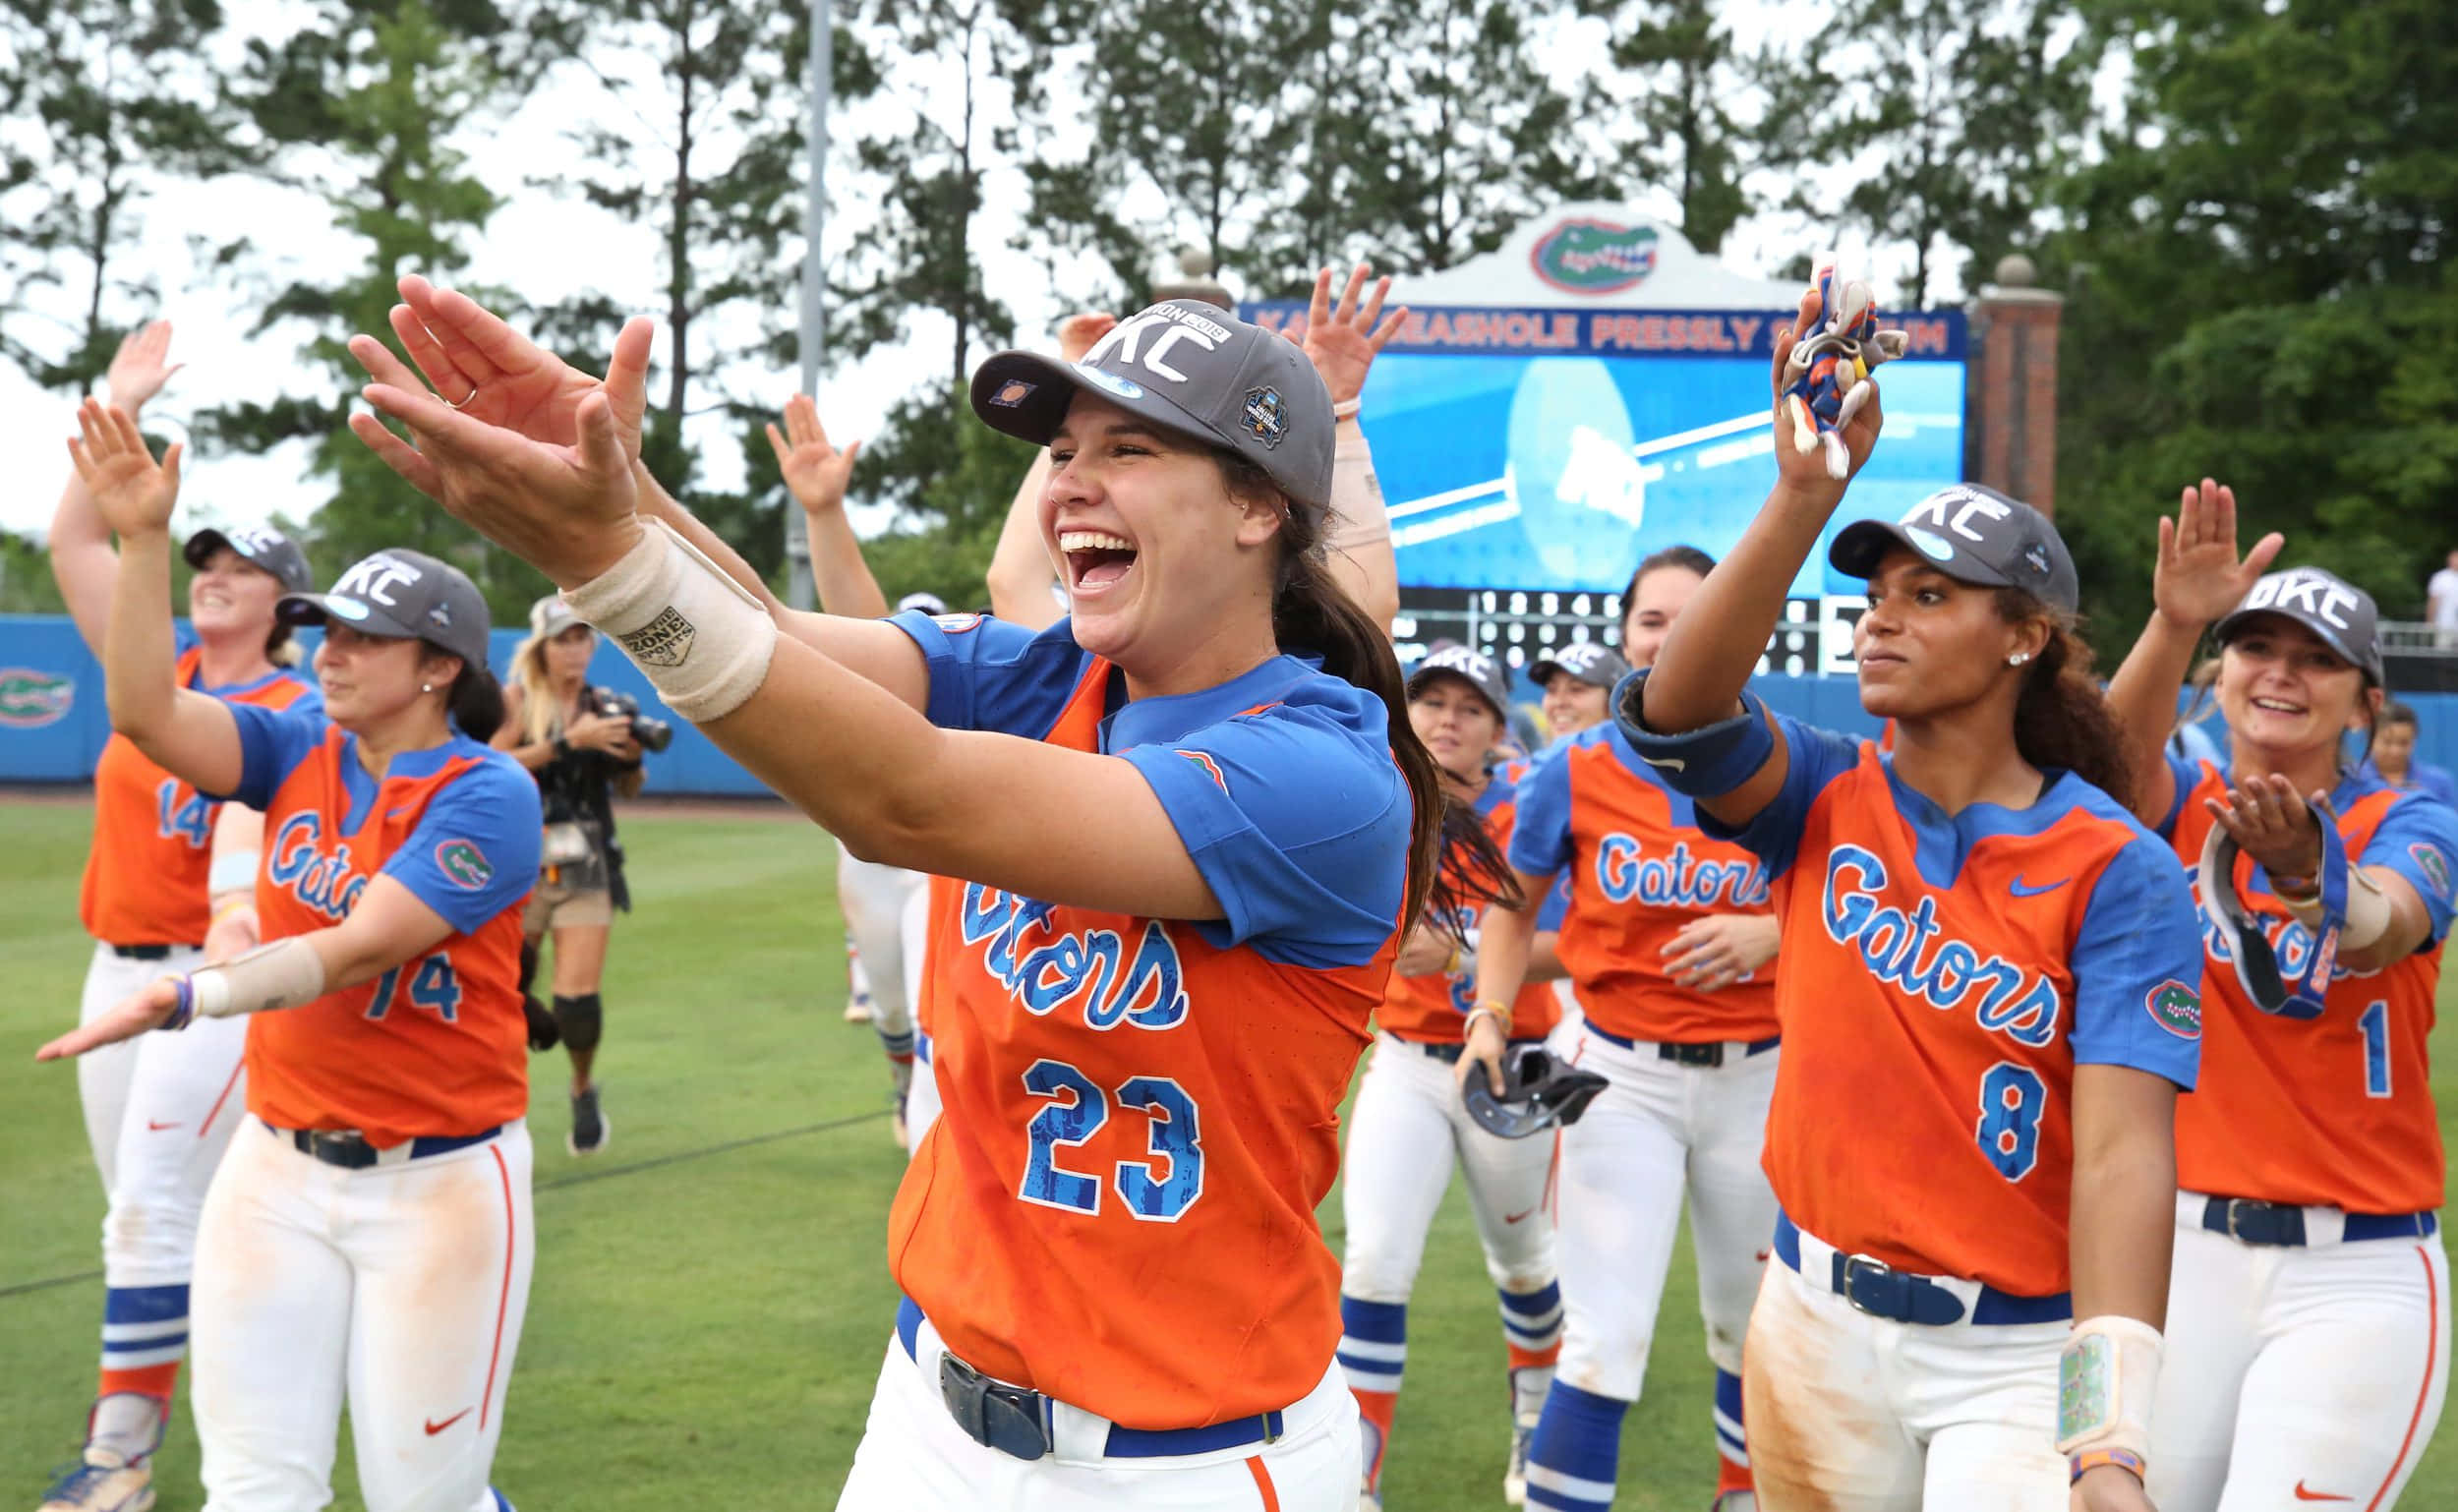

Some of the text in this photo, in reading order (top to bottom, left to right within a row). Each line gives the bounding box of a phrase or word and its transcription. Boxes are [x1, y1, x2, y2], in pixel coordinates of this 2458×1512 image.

[1081, 314, 1215, 382] KC
[1592, 315, 1761, 352] PRESSLY
[1900, 491, 2001, 541] KC
[330, 560, 412, 606] KC
[2246, 575, 2357, 630] OKC
[625, 616, 686, 652] ZONE
[156, 777, 210, 849] 14
[267, 810, 368, 919] Gato
[1597, 832, 1771, 906] Gators
[1822, 843, 2060, 1048] Gators
[2357, 999, 2393, 1099] 1
[1017, 1058, 1205, 1224] 23
[1975, 1060, 2049, 1184] 8
